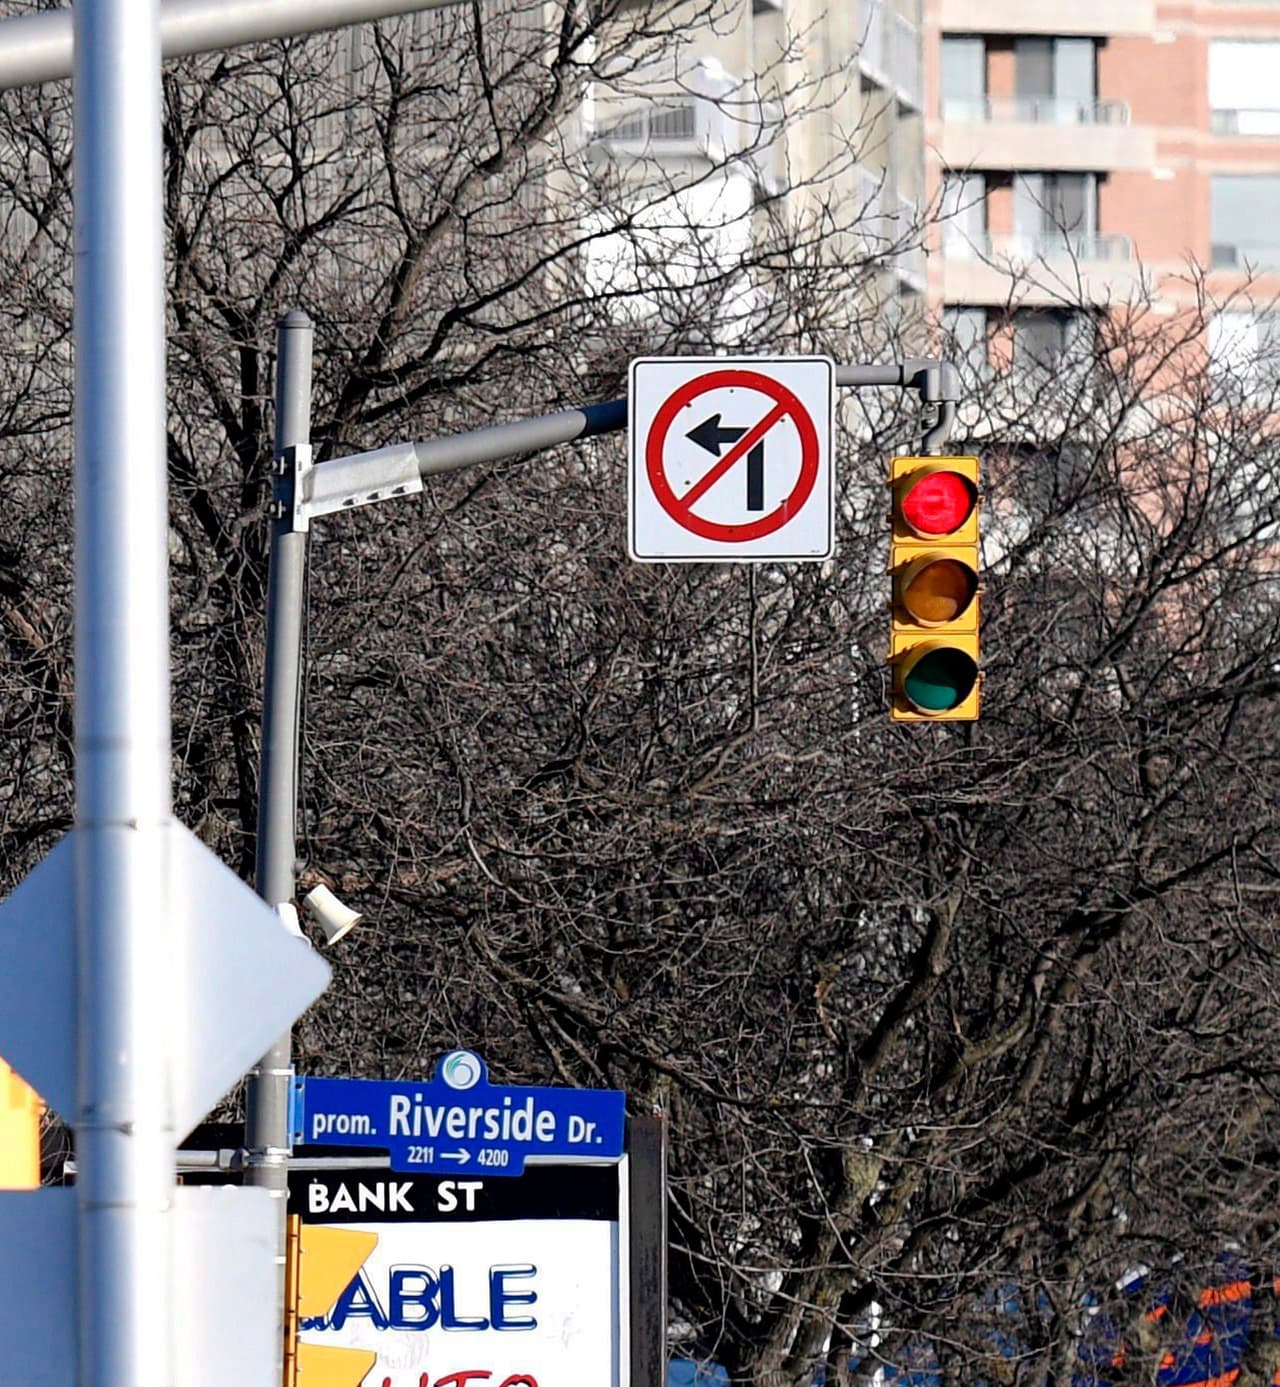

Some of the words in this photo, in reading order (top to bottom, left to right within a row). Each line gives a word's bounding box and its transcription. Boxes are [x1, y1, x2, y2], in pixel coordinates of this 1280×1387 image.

[312, 1112, 377, 1139] prom.
[389, 1093, 556, 1142] Riverside
[567, 1116, 603, 1144] Dr.
[407, 1146, 435, 1164] 2211
[477, 1149, 509, 1167] 4200
[308, 1180, 415, 1214] BANK
[437, 1181, 484, 1212] ST
[298, 1263, 538, 1332] ABLE
